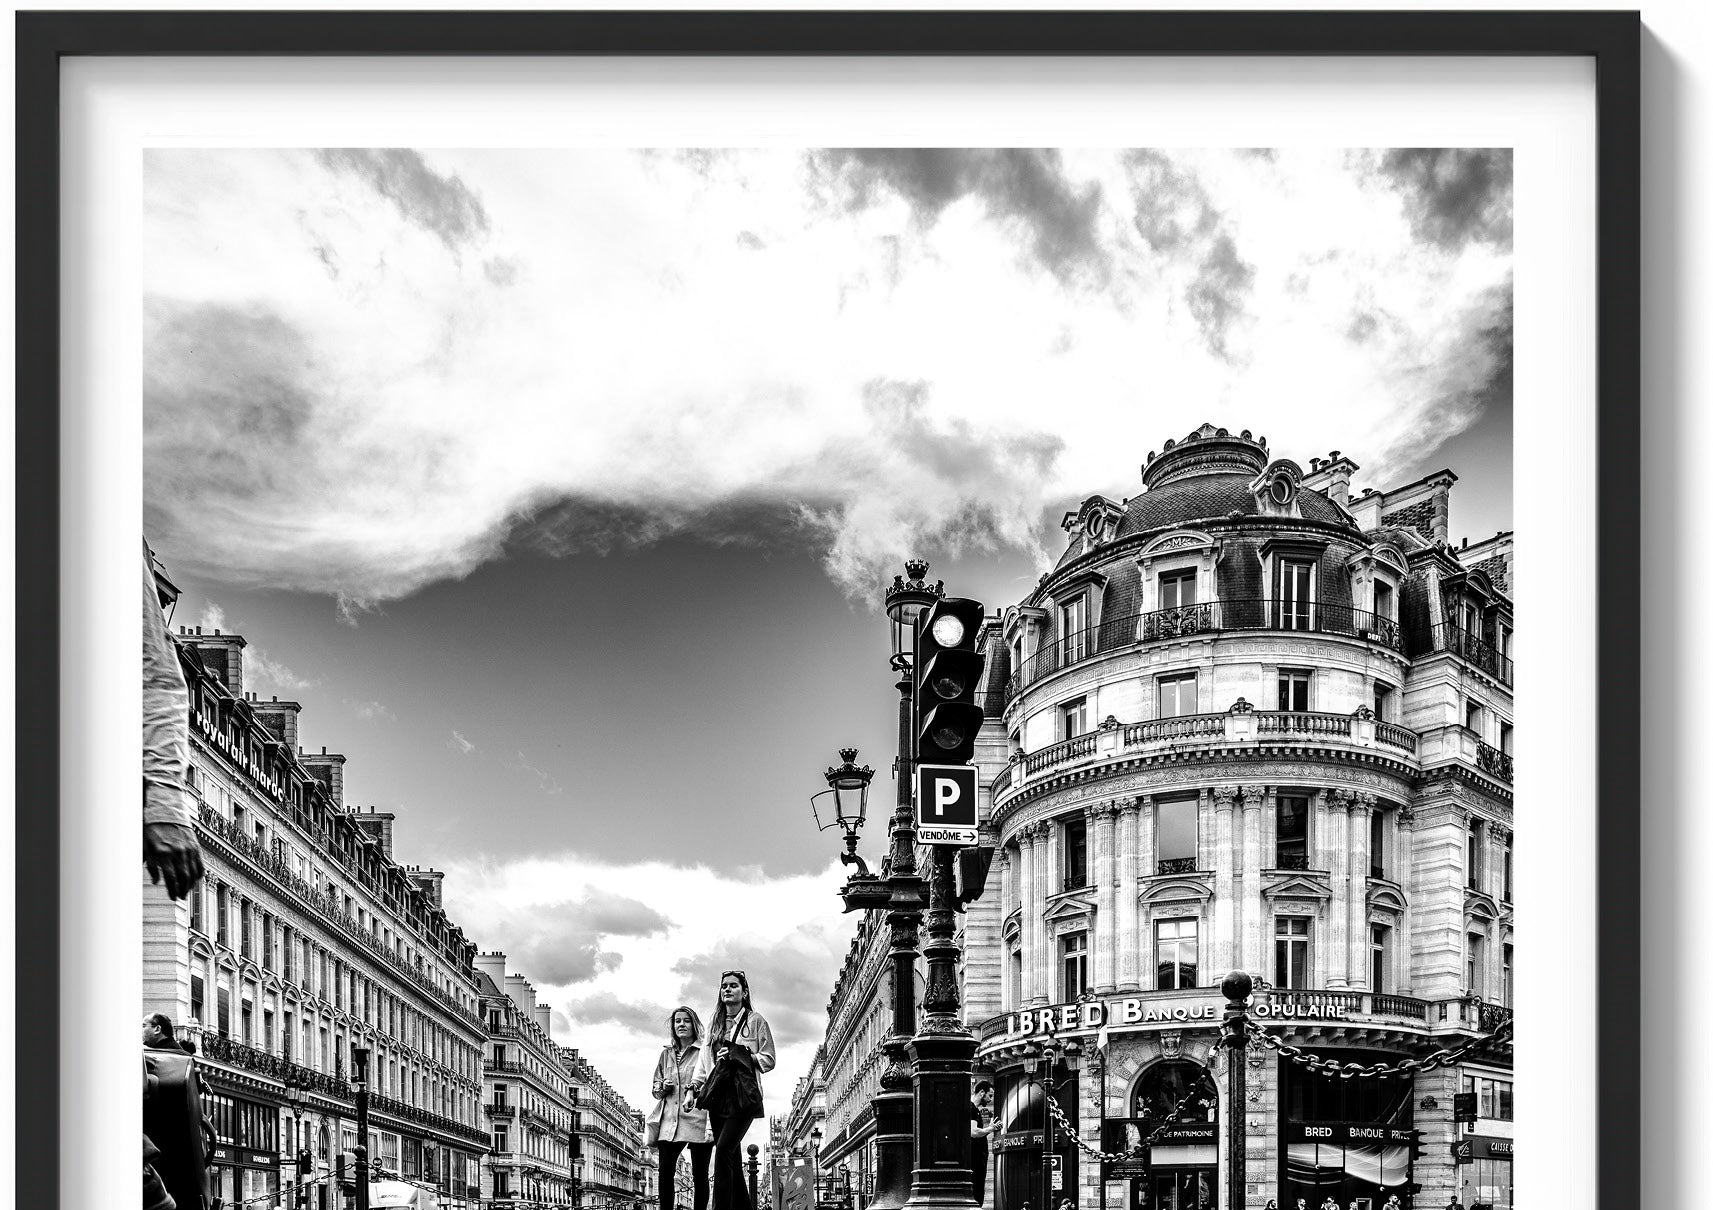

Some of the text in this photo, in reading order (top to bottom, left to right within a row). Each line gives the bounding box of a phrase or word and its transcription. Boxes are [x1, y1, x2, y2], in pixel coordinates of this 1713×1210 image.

[197, 710, 284, 802] royal air maroc
[935, 777, 961, 816] P
[919, 829, 961, 841] VENDÔME
[1122, 999, 1214, 1023] BANQUE
[1173, 1130, 1214, 1138] PATRIMOINE
[1304, 1126, 1333, 1137] BRED
[1349, 1127, 1384, 1139] BANQUE
[1490, 1142, 1509, 1152] CAISSE
